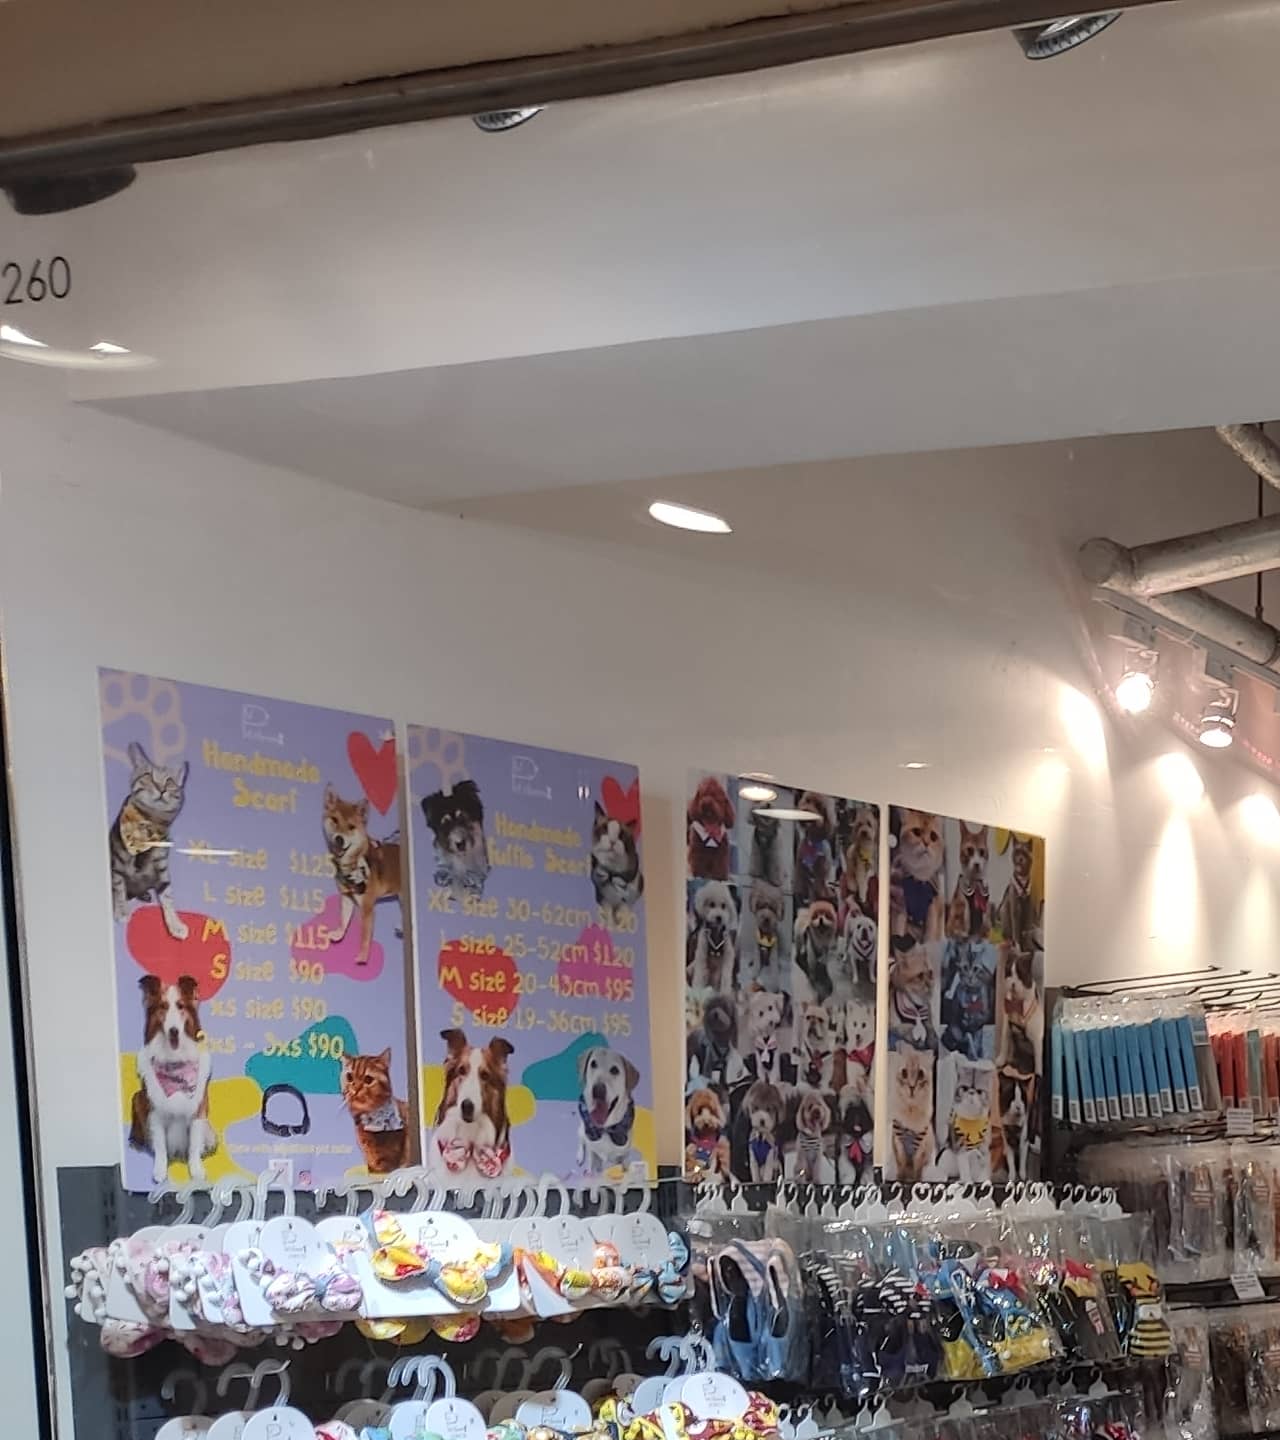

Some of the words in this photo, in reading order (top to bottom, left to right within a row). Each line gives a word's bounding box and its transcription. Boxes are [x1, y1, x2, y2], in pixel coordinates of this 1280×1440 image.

[2, 256, 71, 304] 260
[202, 737, 321, 784] Handmade
[202, 881, 217, 903] L
[226, 884, 266, 907] size
[279, 884, 326, 914] $115
[428, 888, 457, 914] XL
[201, 919, 230, 943] M
[237, 922, 278, 945] size
[286, 921, 333, 950] $115
[439, 928, 452, 951] L
[459, 930, 497, 955] size
[592, 940, 635, 969] $120
[210, 953, 228, 980] S
[236, 959, 274, 982] size
[288, 957, 325, 985] $90
[438, 966, 464, 989] M
[468, 968, 507, 993] size
[603, 977, 635, 1004] $95
[245, 996, 285, 1020] size
[292, 997, 328, 1022] $90
[451, 1002, 466, 1028] S
[471, 1004, 509, 1028] size
[602, 1010, 633, 1038] $95
[307, 1031, 345, 1060] $90
